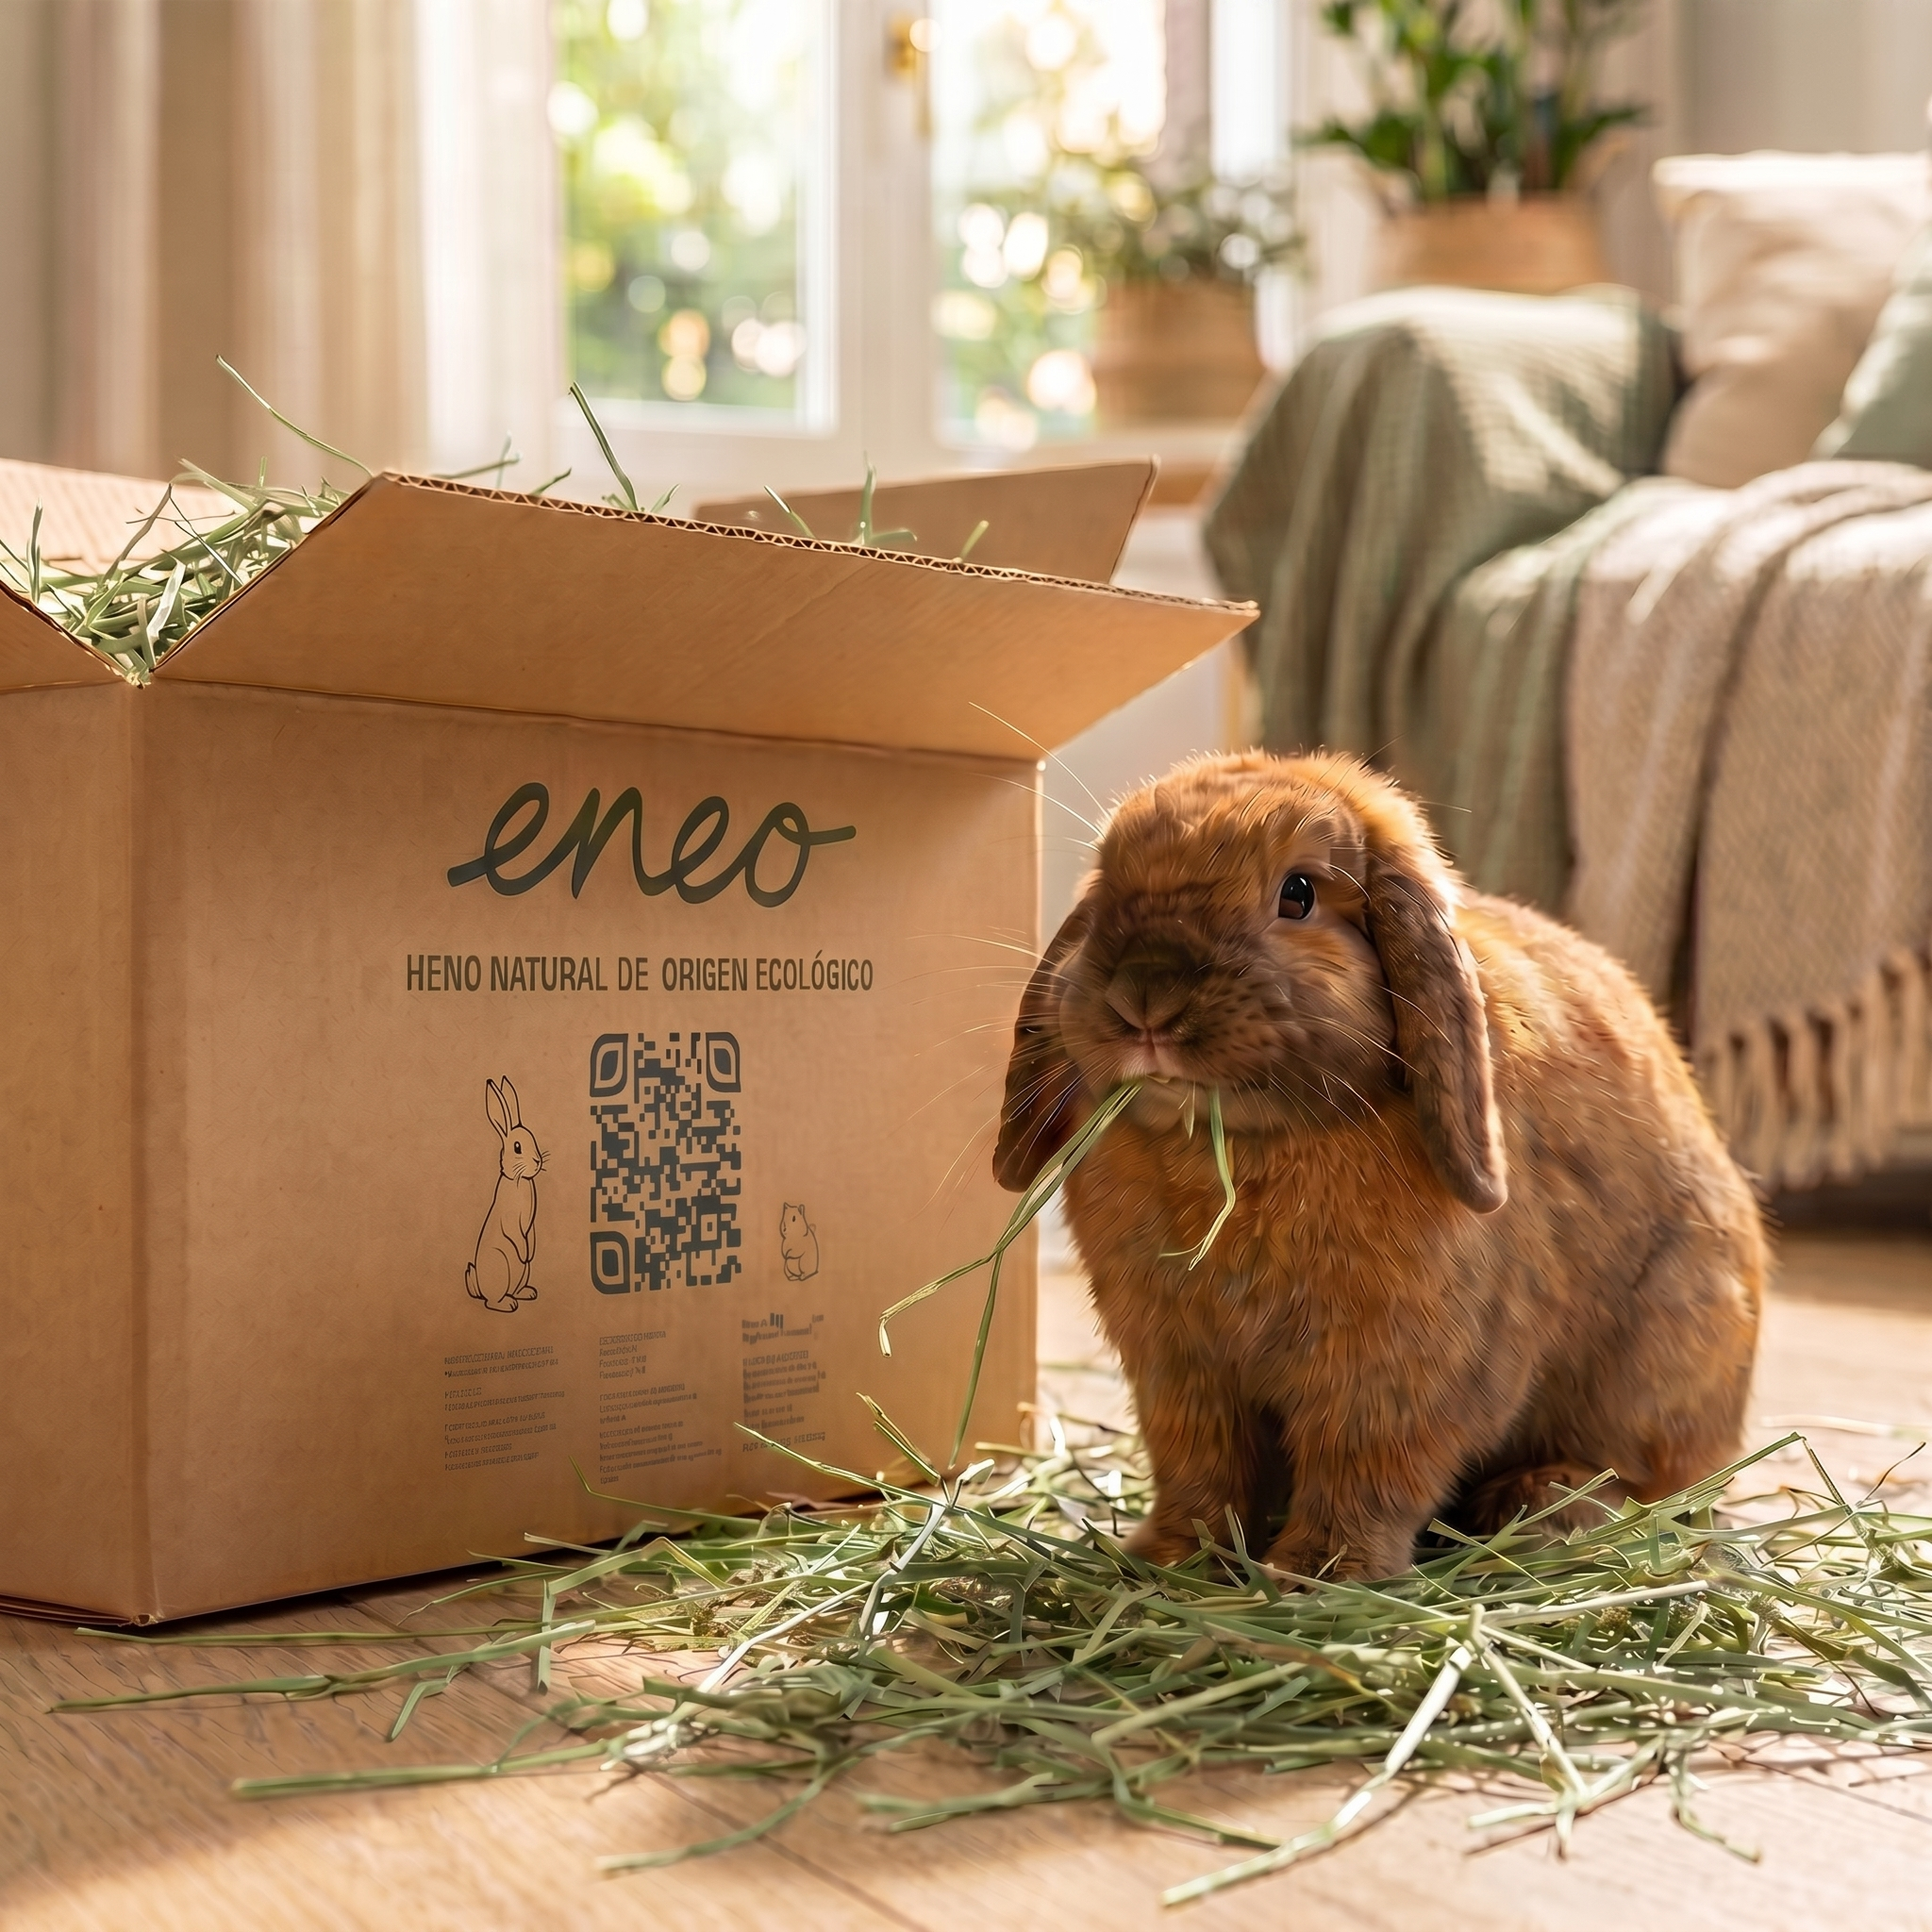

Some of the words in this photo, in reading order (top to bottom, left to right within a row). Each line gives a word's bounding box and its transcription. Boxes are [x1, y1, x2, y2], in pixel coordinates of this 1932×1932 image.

[446, 781, 857, 908] eneo
[407, 954, 482, 992] HENO
[489, 955, 608, 992] NATURAL
[618, 957, 649, 991] DE
[661, 957, 748, 991] ORIGEN
[756, 950, 874, 991] ECOLÓGICO
